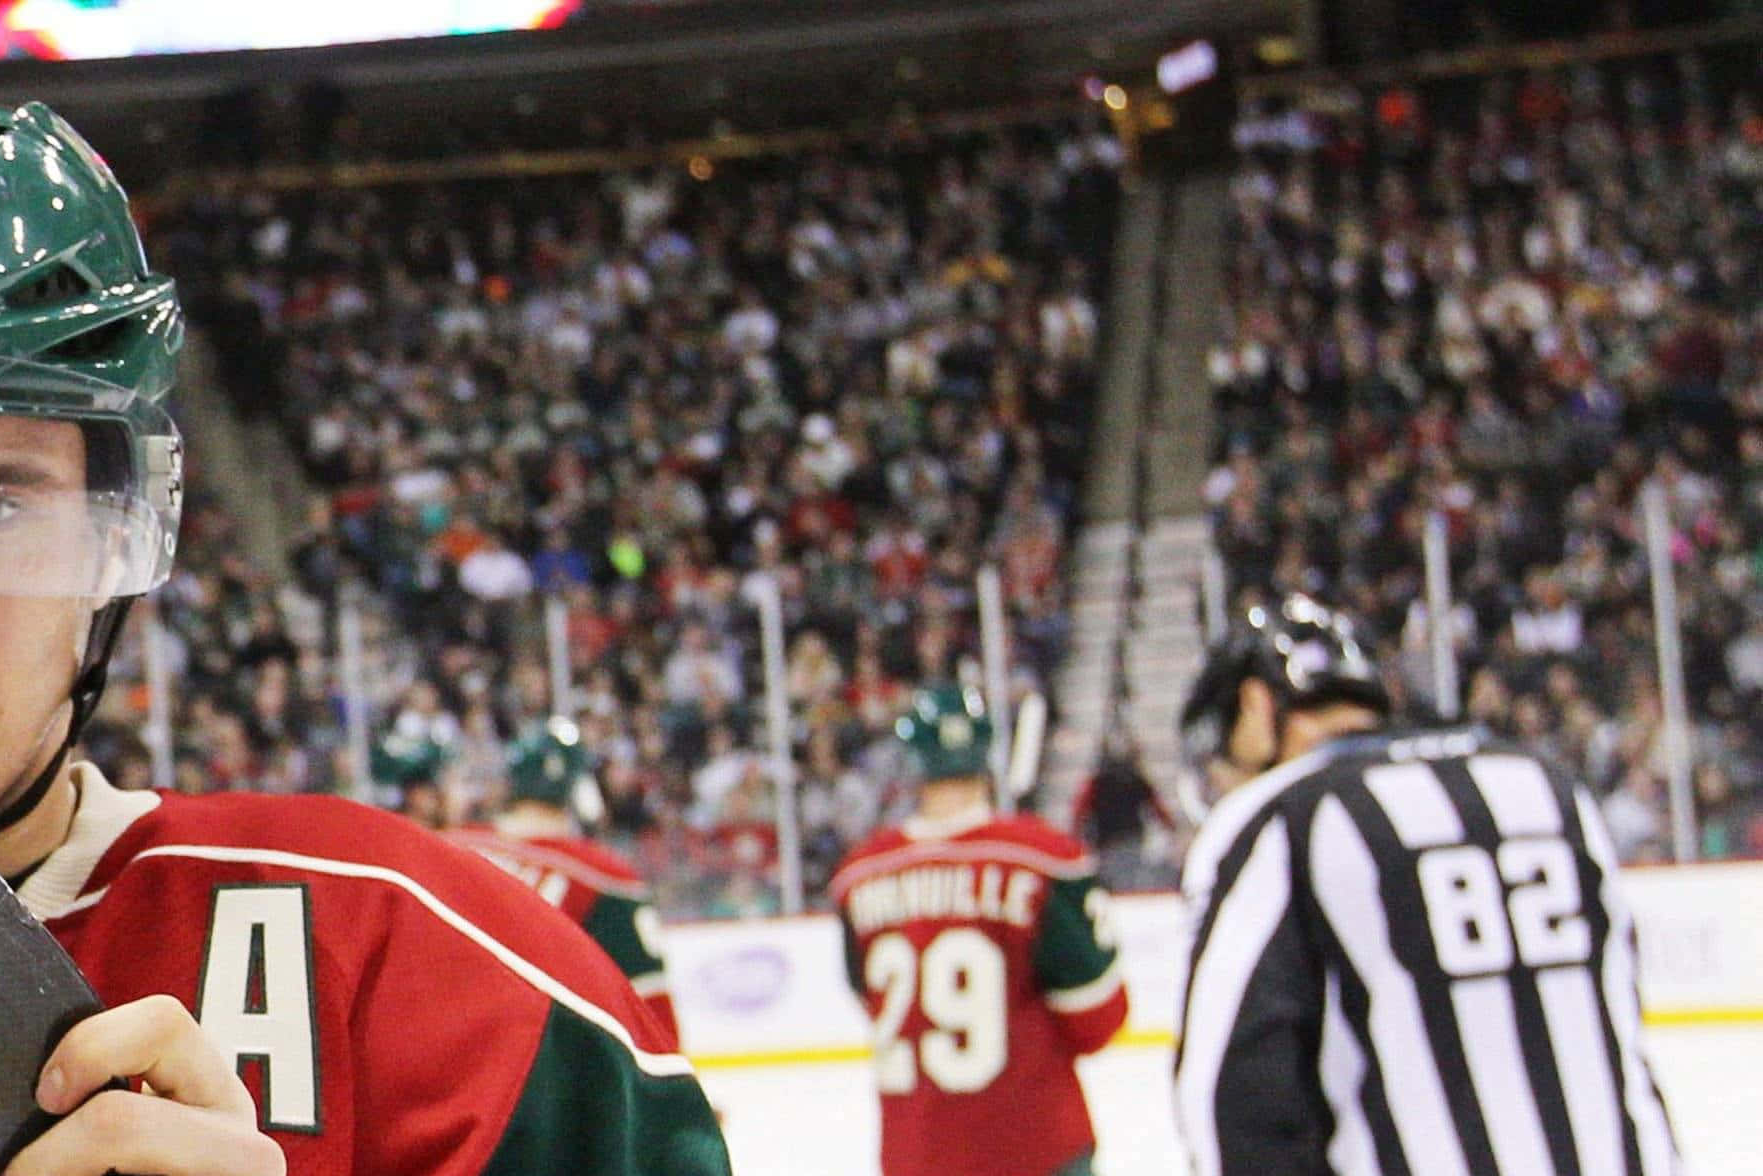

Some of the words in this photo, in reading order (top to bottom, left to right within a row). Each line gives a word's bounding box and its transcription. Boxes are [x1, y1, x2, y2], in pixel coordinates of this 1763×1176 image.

[1416, 834, 1592, 978] 82
[196, 883, 323, 1135] A
[863, 927, 1009, 1096] 29
